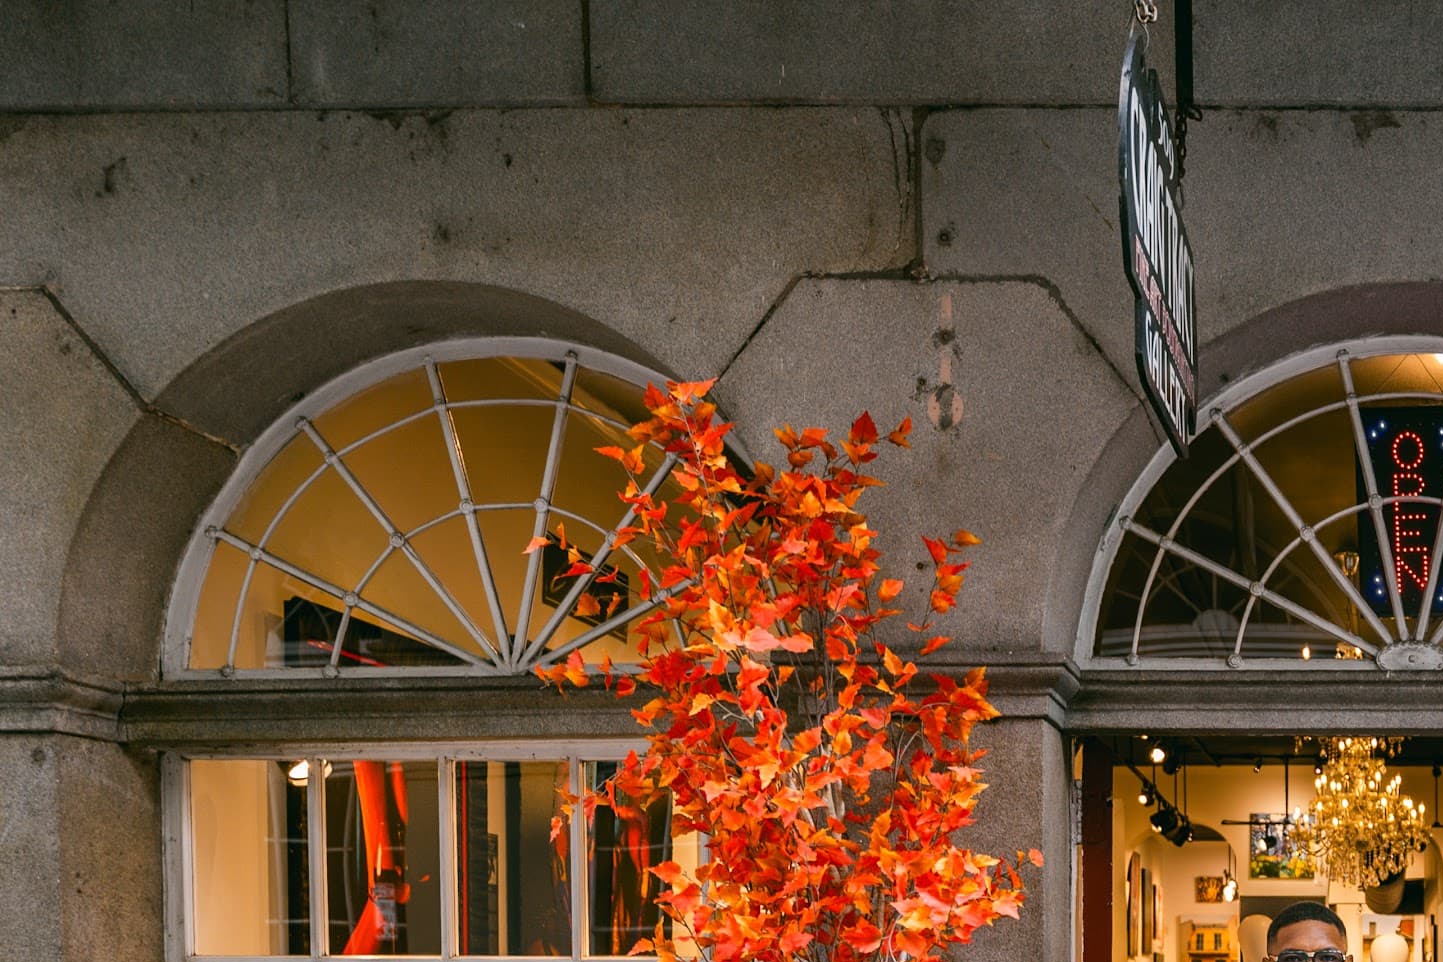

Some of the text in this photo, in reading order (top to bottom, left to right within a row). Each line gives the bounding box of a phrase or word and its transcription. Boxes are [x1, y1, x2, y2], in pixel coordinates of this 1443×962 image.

[1130, 86, 1165, 295] CRAIG
[1165, 186, 1194, 366] TRACY
[1145, 310, 1186, 446] GALLERY
[1392, 430, 1429, 594] OPEN
